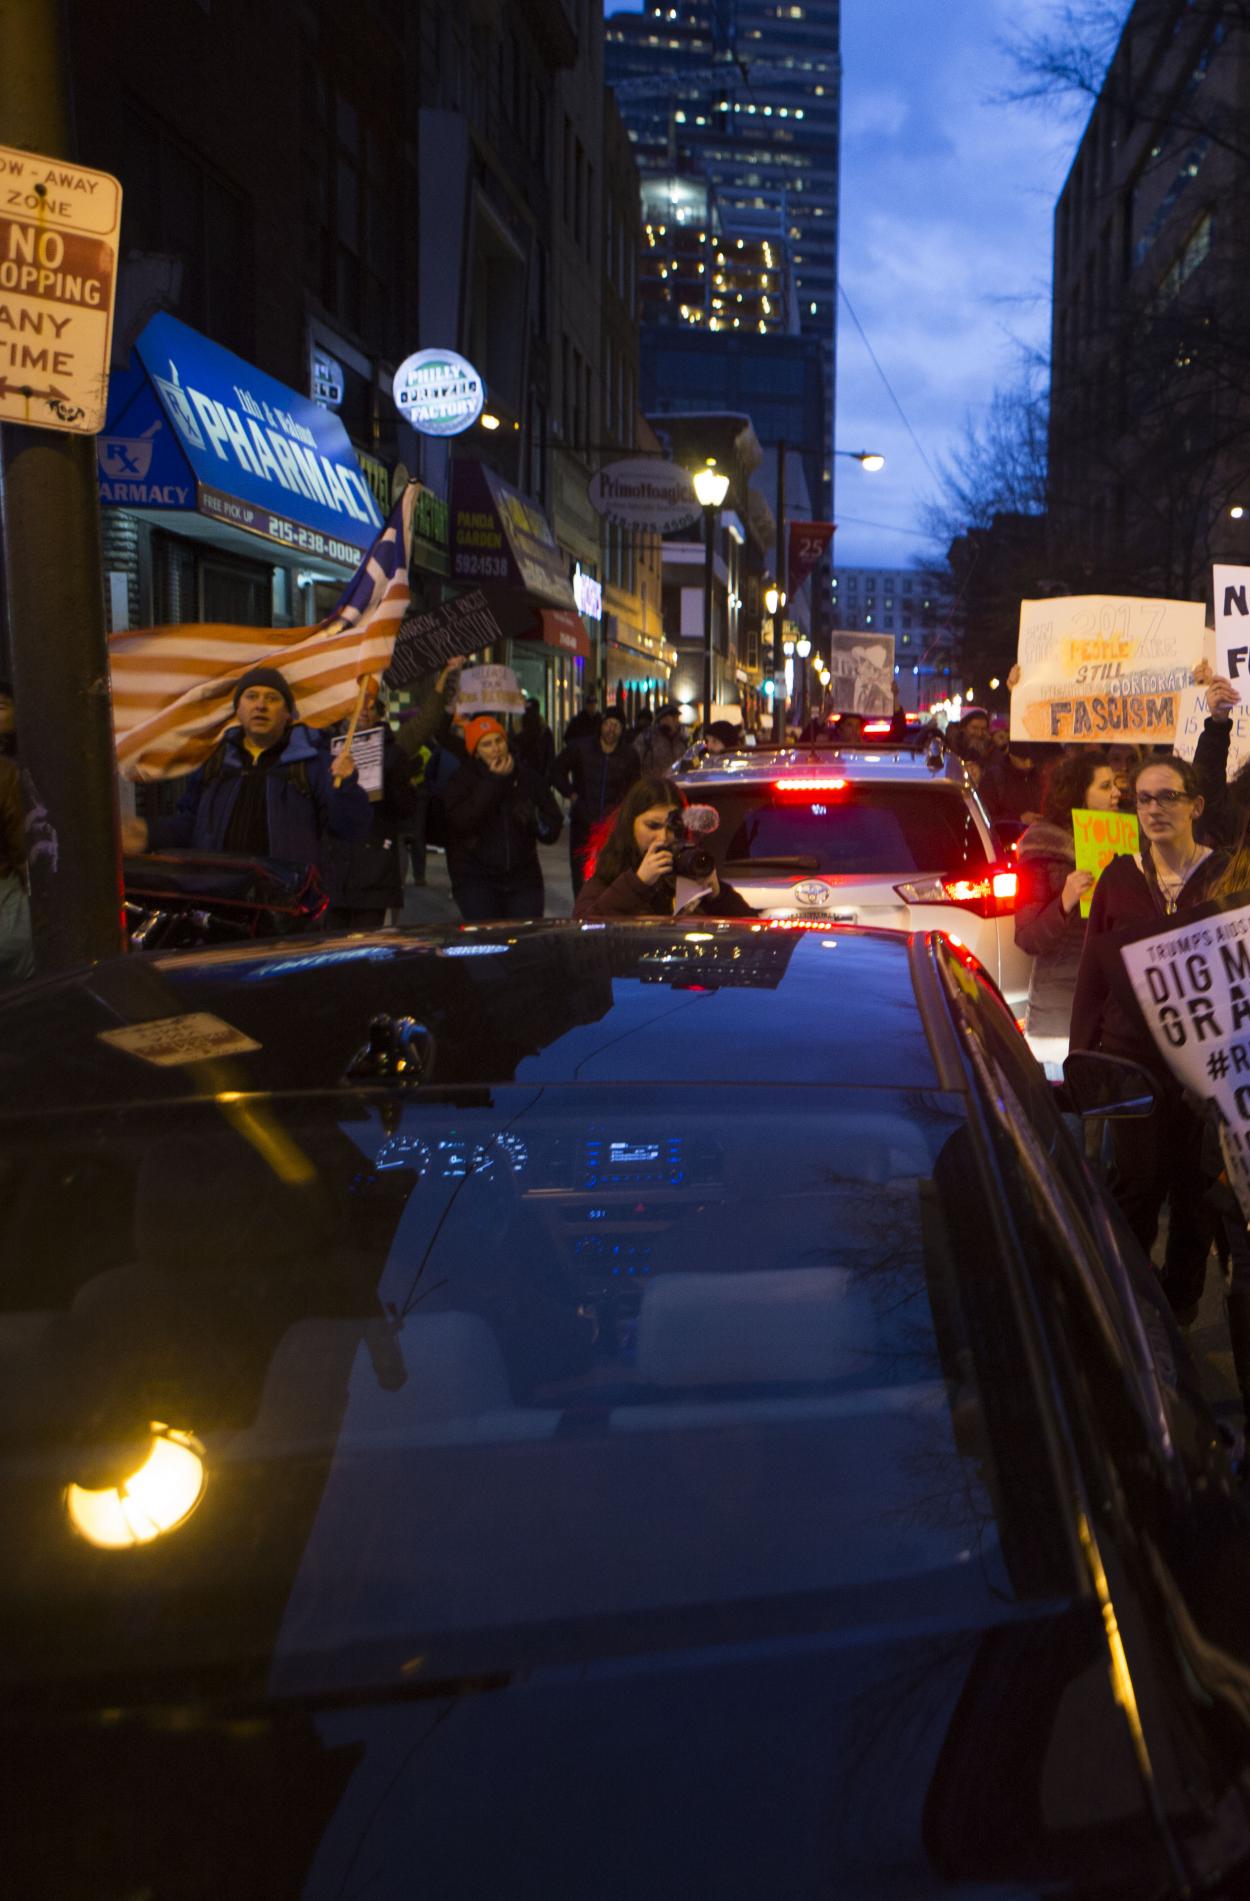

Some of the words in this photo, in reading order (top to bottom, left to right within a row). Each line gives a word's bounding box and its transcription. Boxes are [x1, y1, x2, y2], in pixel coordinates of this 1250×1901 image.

[44, 170, 99, 195] AWAY
[7, 189, 72, 218] ZONE
[9, 222, 64, 271] NO
[0, 260, 101, 305] OPPING
[407, 364, 459, 386] PHILLY
[410, 399, 477, 422] FACTORY
[187, 385, 382, 528] PHARMACY
[100, 483, 189, 505] ARMACY
[269, 516, 361, 566] 215-238-0002
[1076, 662, 1125, 684] STILL
[1050, 697, 1175, 737] FASCISM
[1145, 954, 1212, 1004] DIG
